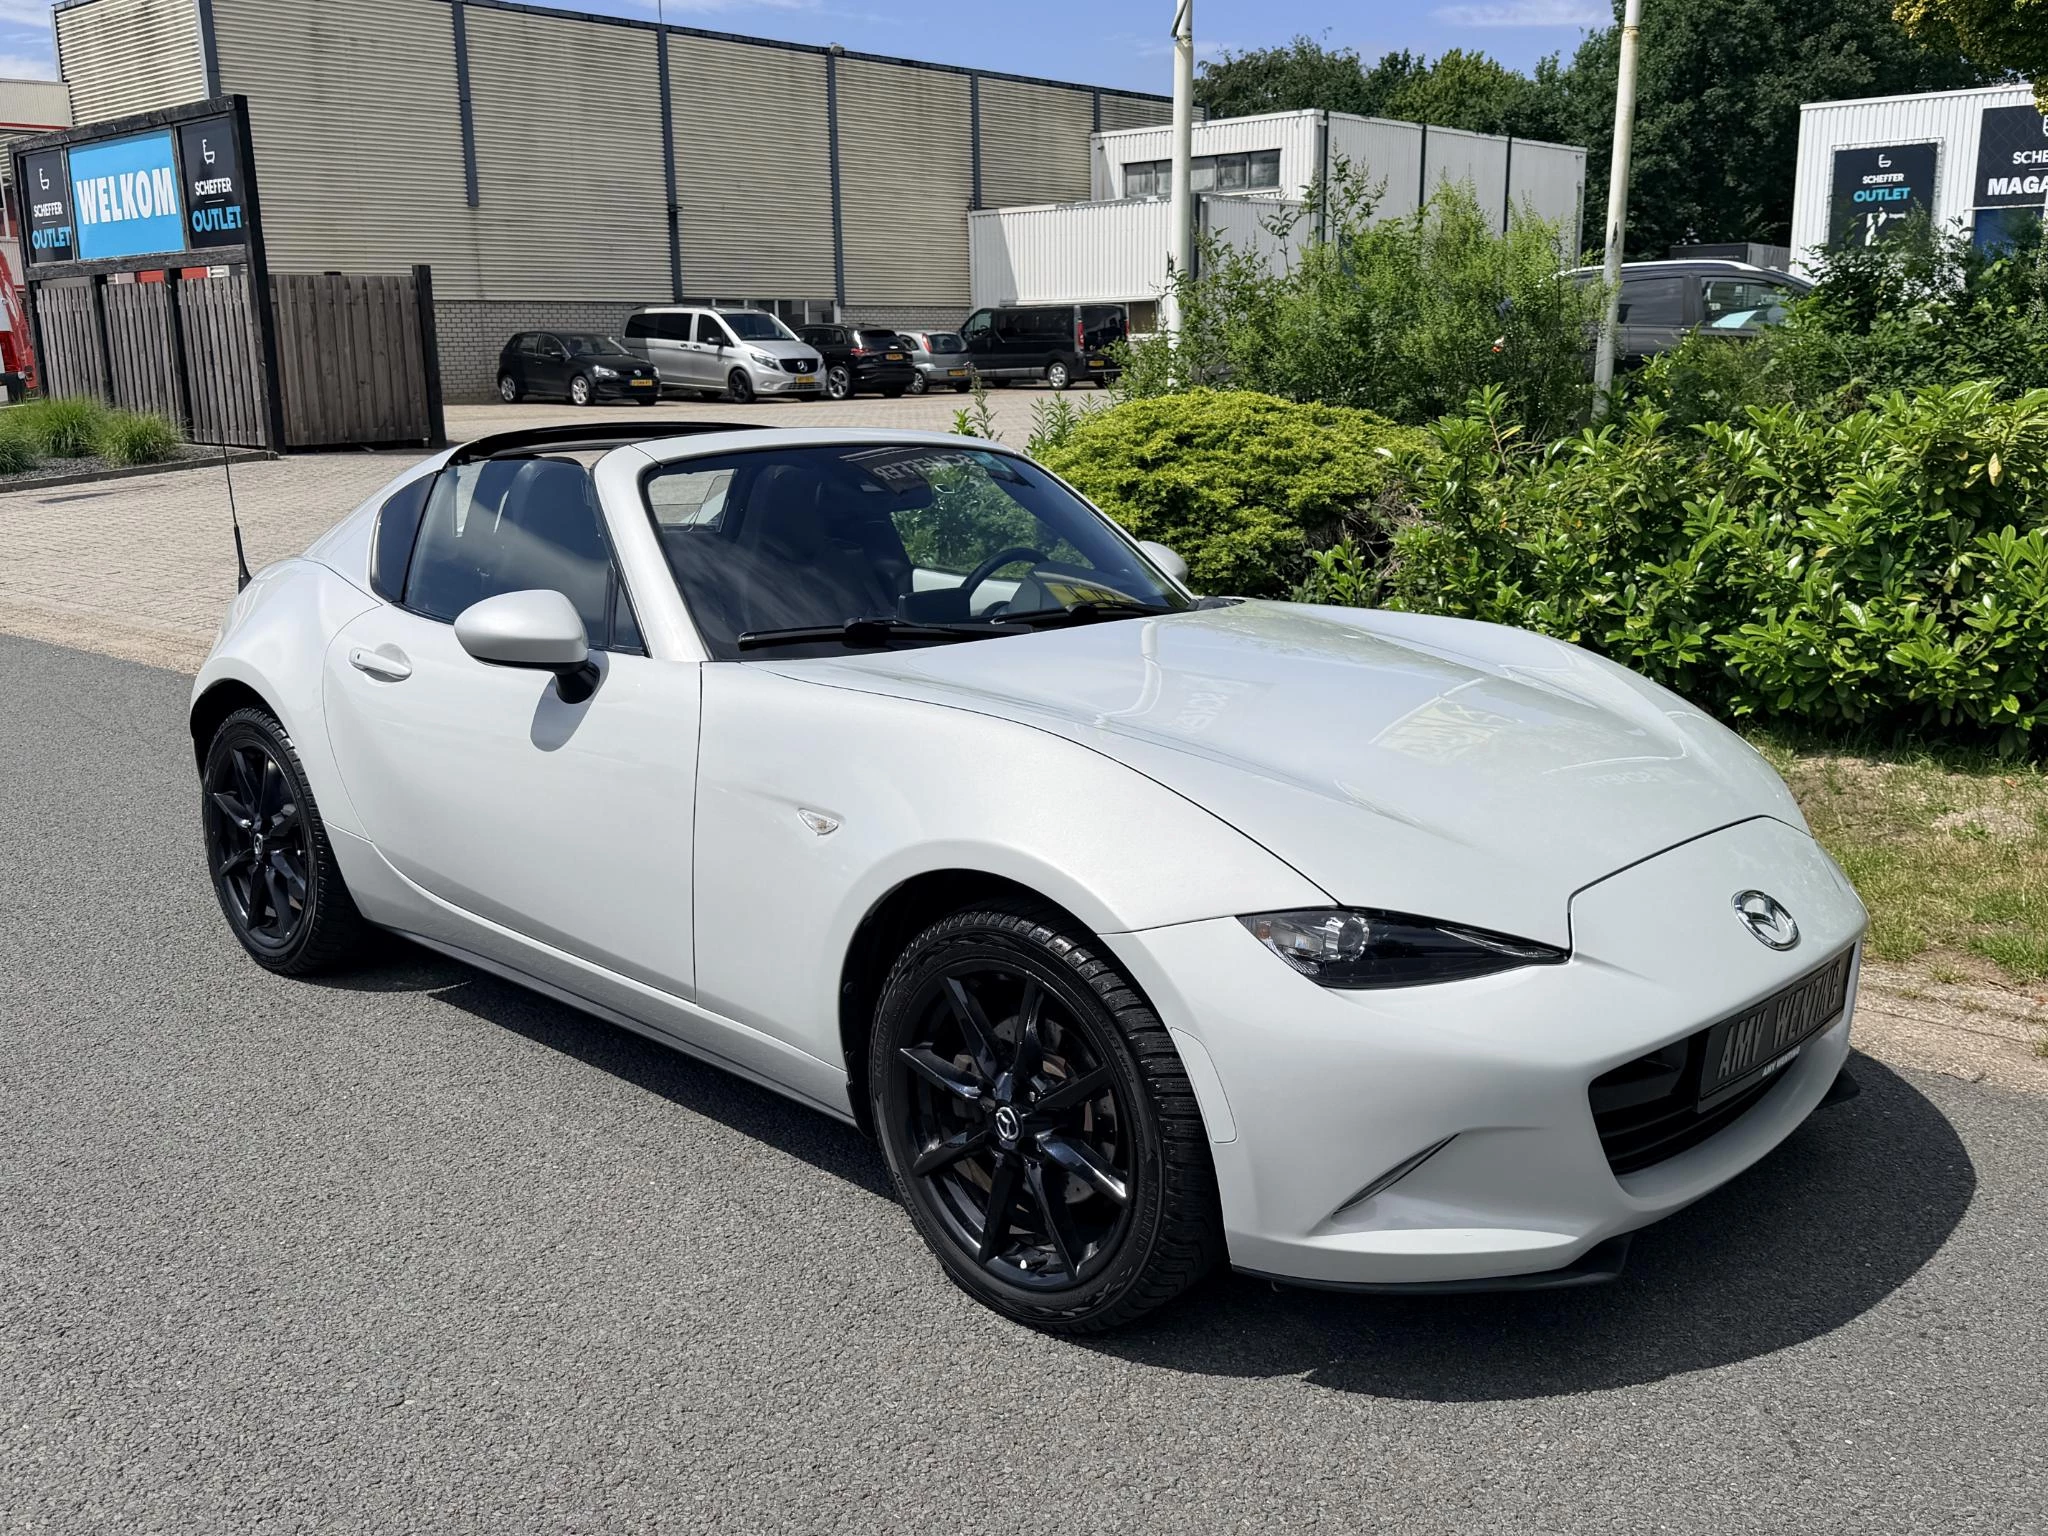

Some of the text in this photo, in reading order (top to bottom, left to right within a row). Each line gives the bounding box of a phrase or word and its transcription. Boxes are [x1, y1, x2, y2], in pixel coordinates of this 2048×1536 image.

[194, 176, 232, 197] SCHEFFER
[1862, 172, 1905, 184] SCHEFFER
[75, 167, 177, 225] WELKOM
[1853, 186, 1911, 203] OUTLET
[33, 201, 63, 218] SCHEFFER
[192, 205, 241, 233] OUTLET
[32, 225, 72, 250] OUTLET
